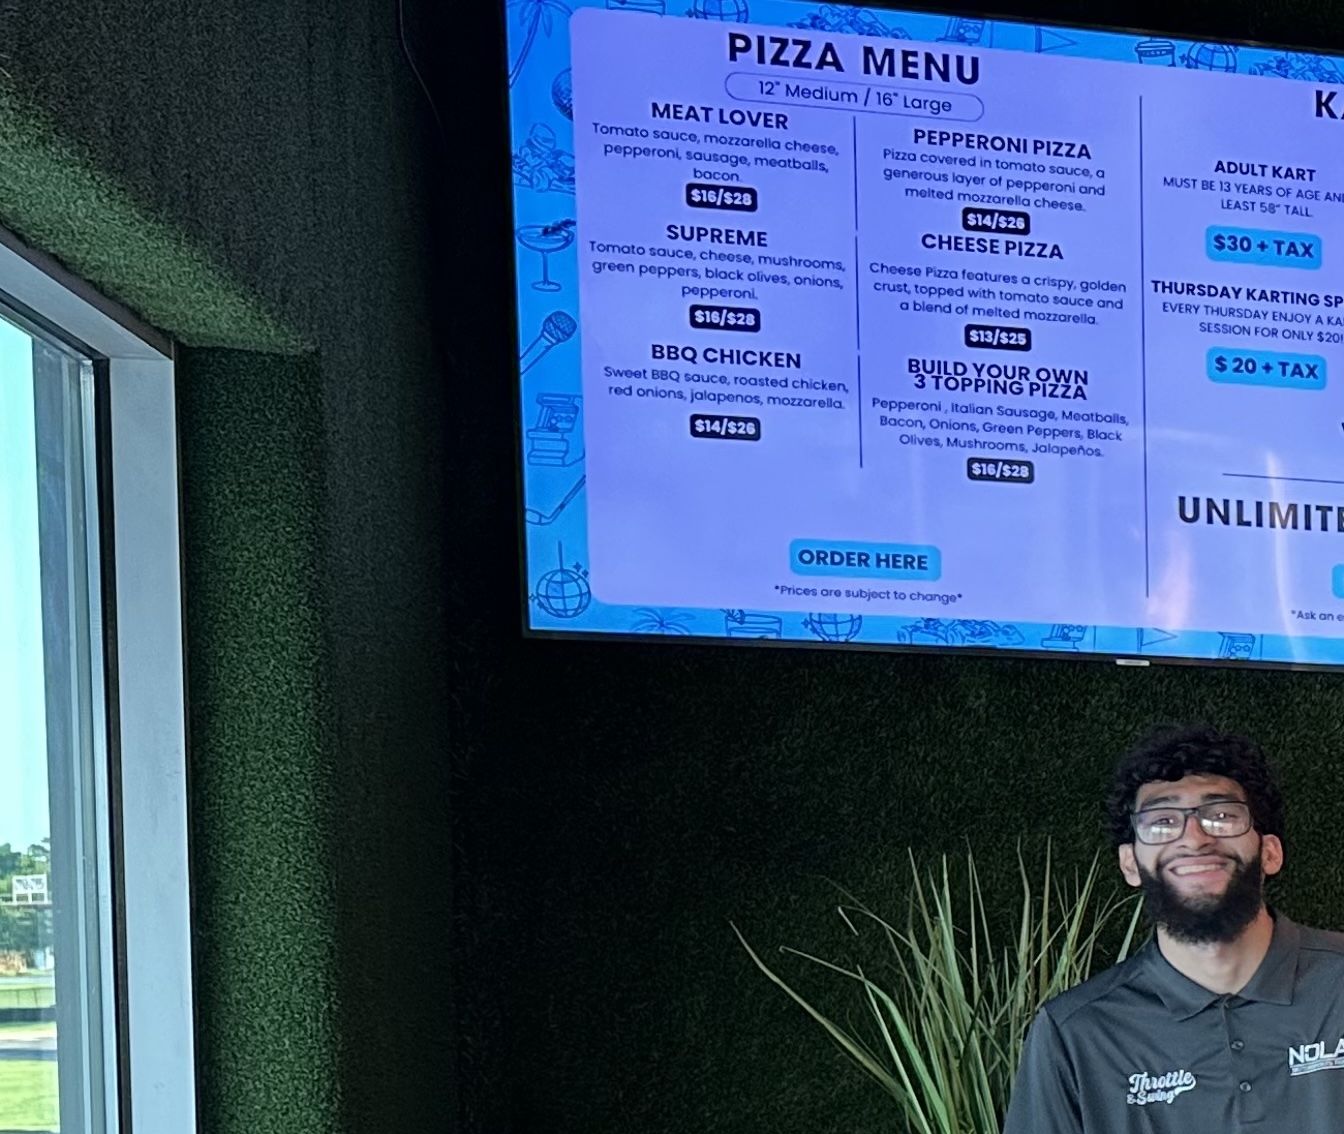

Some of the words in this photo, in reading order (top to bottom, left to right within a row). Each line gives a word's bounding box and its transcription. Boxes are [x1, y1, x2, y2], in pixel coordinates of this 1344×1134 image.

[728, 32, 844, 72] PIZZA
[863, 45, 978, 84] MENU
[785, 84, 857, 103] Medium
[903, 95, 951, 115] Large
[651, 102, 713, 122] MEAT
[719, 108, 787, 129] LOVER
[592, 122, 649, 138] Tomato
[652, 130, 700, 144] sauce,
[704, 134, 780, 149] mozzarella
[784, 140, 838, 155] cheese,
[914, 128, 1027, 153] PEPPERONI
[1033, 139, 1091, 159] PIZZA
[1214, 160, 1267, 176] ADULT
[1272, 165, 1316, 181] KART
[691, 188, 752, 206] $16/$28
[967, 212, 1025, 229] $14/$26
[666, 224, 767, 247] SUPREME
[921, 233, 999, 254] CHEESE
[1005, 240, 1063, 259] PIZZA
[1213, 233, 1251, 252] $30
[1257, 240, 1268, 251] +
[1273, 240, 1313, 258] TAX
[1151, 280, 1242, 300] THURSDAY
[1246, 288, 1320, 306] KARTING
[694, 309, 755, 327] $16/$28
[969, 329, 1027, 346] $13/$25
[651, 344, 697, 364] BBQ
[703, 347, 800, 368] CHICKEN
[1215, 355, 1227, 372] $
[1232, 357, 1256, 374] 20
[1261, 362, 1273, 373] +
[1278, 361, 1318, 379] TAX
[908, 358, 967, 376] BUILD
[972, 362, 1030, 381] YOUR
[1035, 367, 1087, 385] OWN
[914, 375, 925, 388] 3
[931, 375, 1023, 395] TOPPING
[1029, 381, 1087, 400] PIZZA
[694, 419, 756, 437] $14/$26
[972, 462, 1029, 479] $16/$28
[798, 549, 870, 567] ORDER
[876, 552, 927, 570] HERE
[820, 588, 841, 597] are
[845, 588, 890, 601] subject
[893, 590, 906, 600] to
[1129, 1070, 1196, 1093] Throttle
